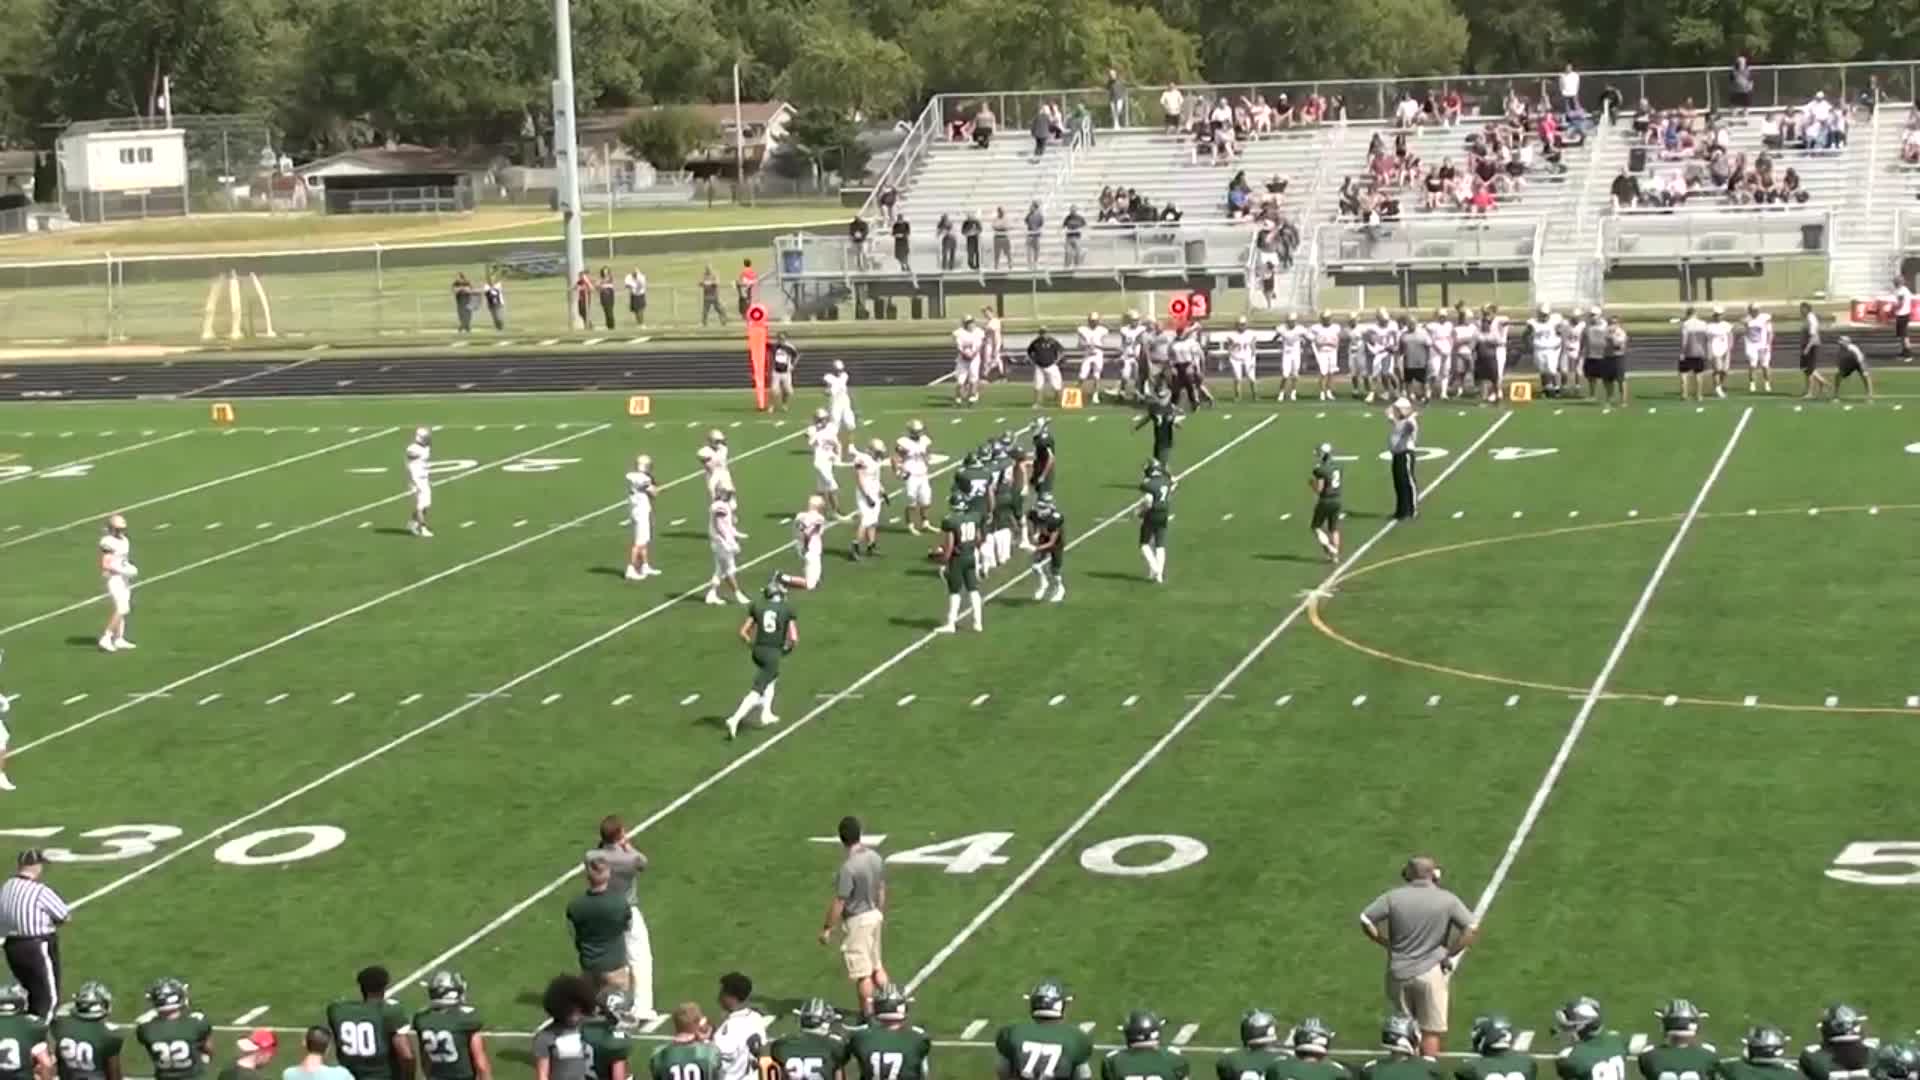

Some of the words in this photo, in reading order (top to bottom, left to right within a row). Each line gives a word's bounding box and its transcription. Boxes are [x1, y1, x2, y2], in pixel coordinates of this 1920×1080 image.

[1191, 294, 1206, 316] 3
[763, 610, 777, 633] 6
[340, 1021, 376, 1056] 90
[422, 1030, 459, 1062] 23
[152, 1040, 192, 1069] 32
[869, 1052, 903, 1080] 17
[1021, 1041, 1063, 1080] 77
